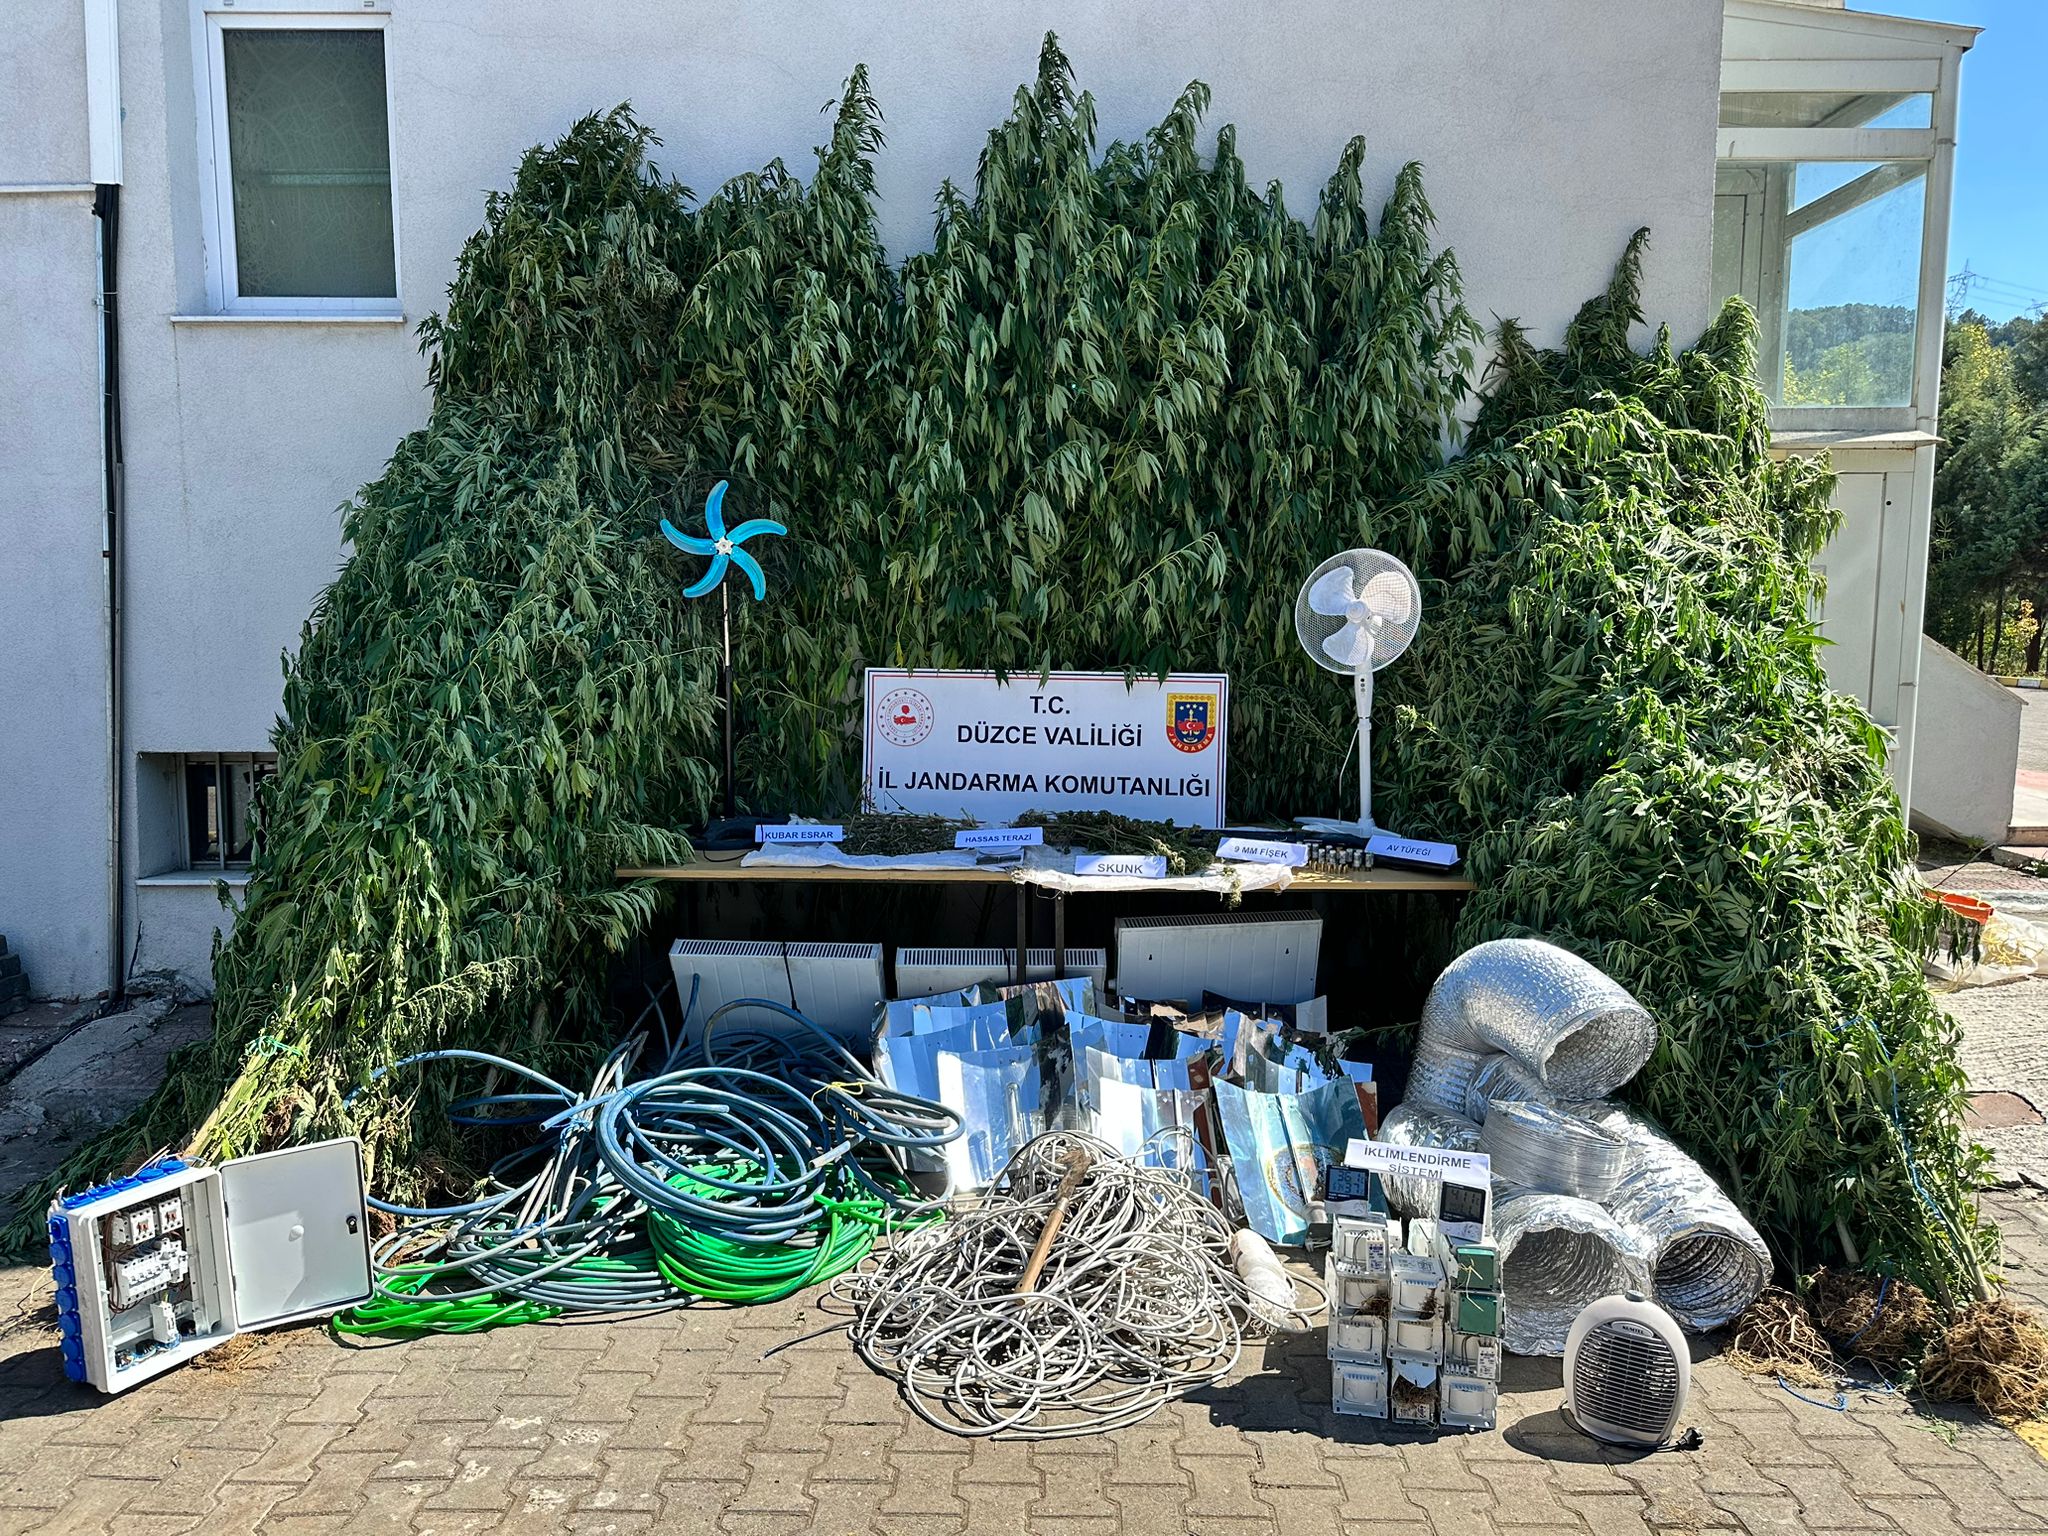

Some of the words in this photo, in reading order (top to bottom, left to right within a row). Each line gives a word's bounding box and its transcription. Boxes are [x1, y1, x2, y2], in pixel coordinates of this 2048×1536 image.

[1030, 695, 1071, 714] T.C.
[957, 722, 1037, 744] DÜZCE
[1044, 724, 1143, 747] VALİLİĞİ
[1168, 731, 1214, 752] JANDARMA
[878, 766, 898, 789] İL
[904, 771, 1038, 793] JANDARMA
[1045, 774, 1211, 797] KOMUTANLIĞI
[765, 830, 798, 841] KUBAR
[801, 829, 834, 839] ESRAR
[965, 834, 999, 843] HASSAS
[1001, 832, 1032, 842] TERAZİ
[1241, 847, 1258, 855] MM
[1259, 848, 1288, 859] FİŞEK
[1400, 845, 1432, 856] TÜFEĞİ
[1097, 863, 1143, 875] SKUNK
[1363, 1145, 1472, 1169] İKLİMLENDİRME
[1388, 1163, 1443, 1179] SİSTEMİ
